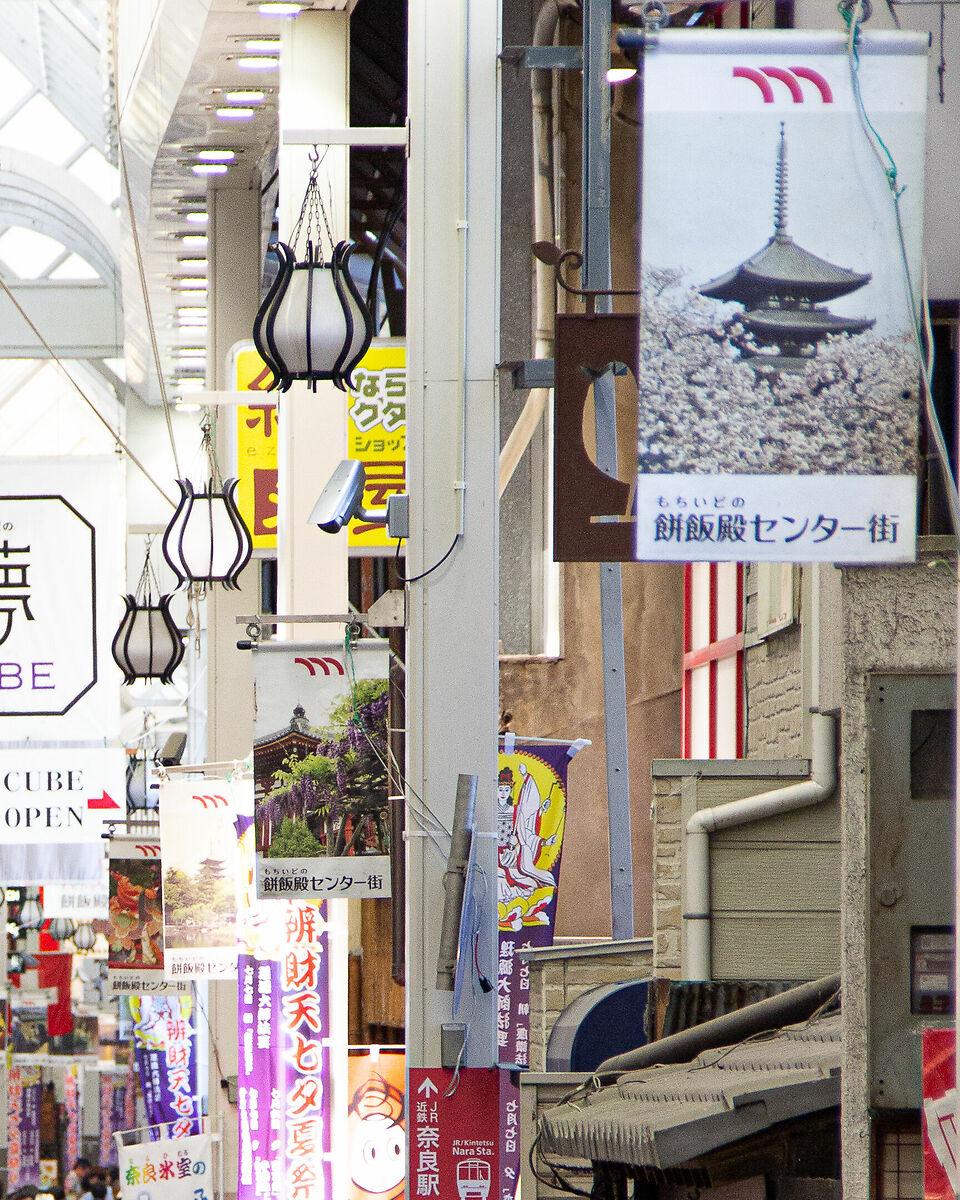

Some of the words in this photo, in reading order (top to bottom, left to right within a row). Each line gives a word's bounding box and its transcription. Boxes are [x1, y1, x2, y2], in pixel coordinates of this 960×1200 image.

[355, 436, 406, 452] ショッ
[655, 495, 746, 509] もちいどの
[653, 513, 899, 545] 餅飯殿センター街
[263, 867, 308, 875] もちいどの
[263, 874, 383, 893] 餅飯殿センター街
[452, 1146, 475, 1156] Nara
[476, 1146, 495, 1156] Sta.
[416, 1125, 441, 1197] 奈良駅
[125, 1157, 207, 1187] 奈良氷室の
